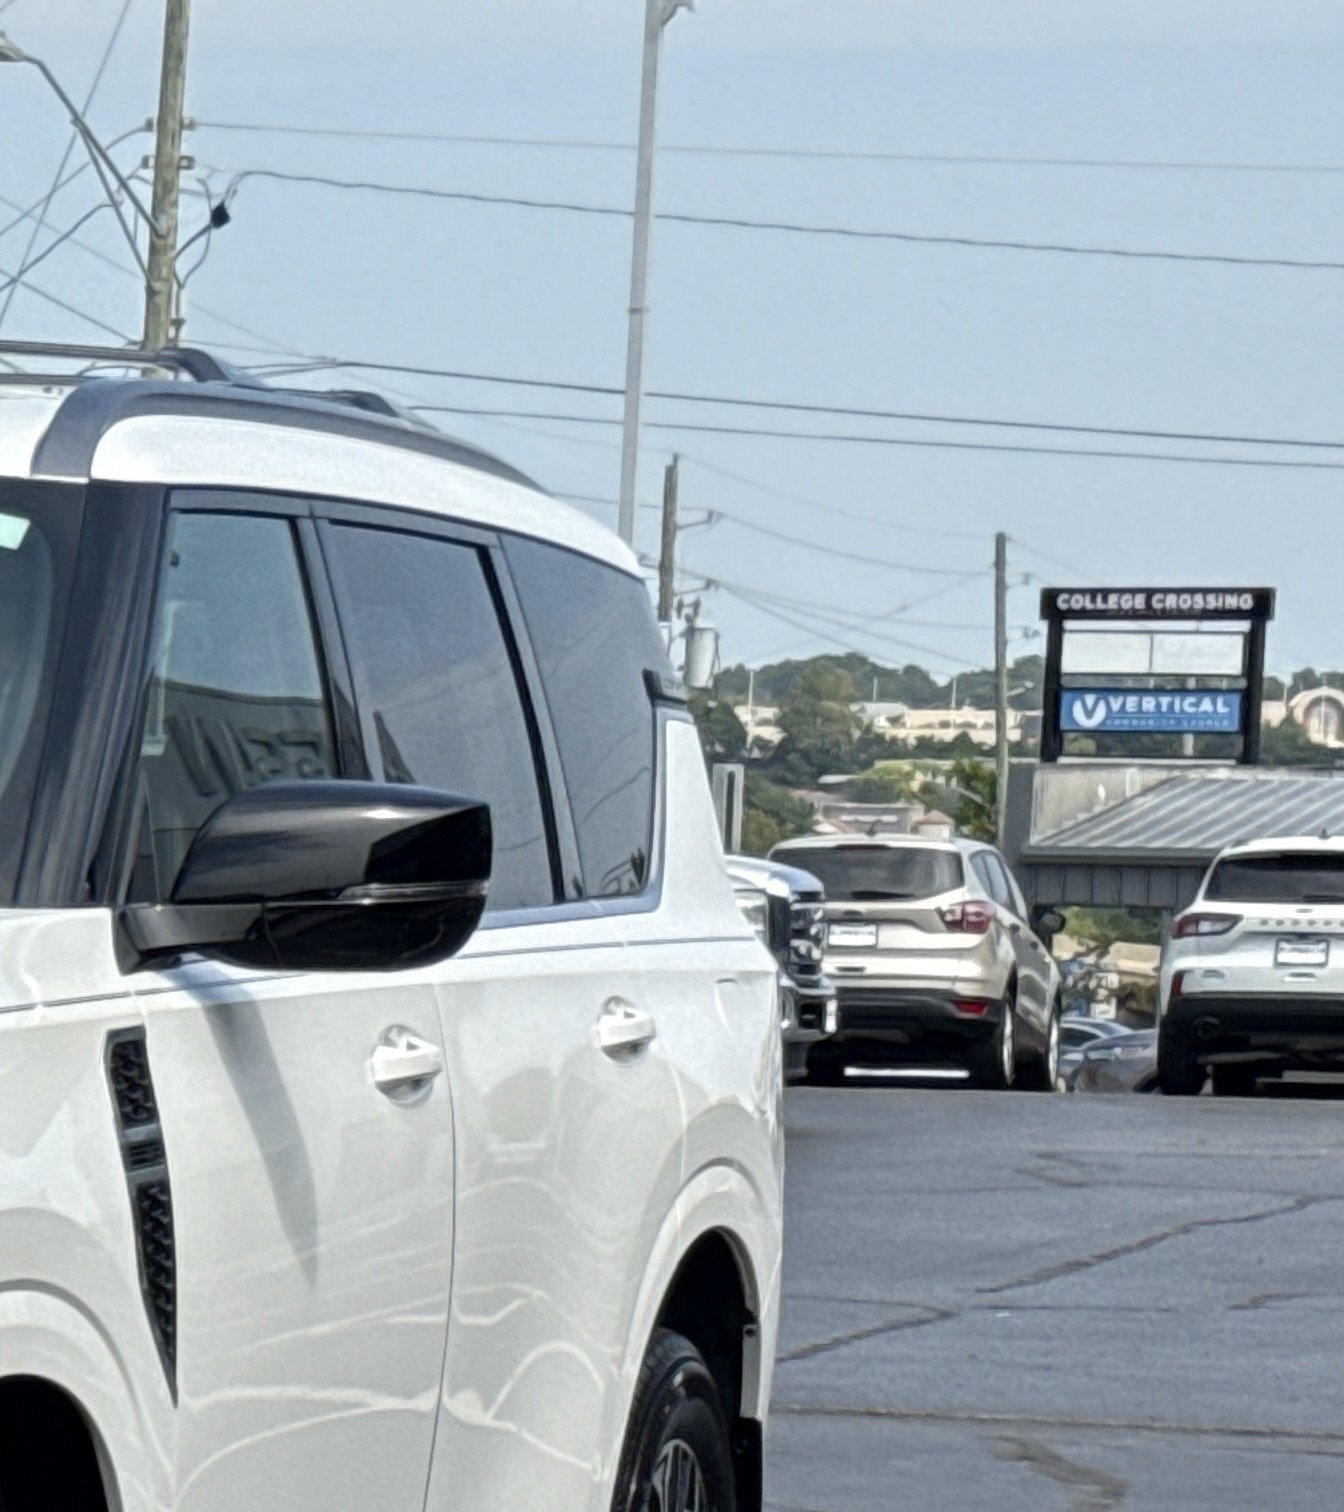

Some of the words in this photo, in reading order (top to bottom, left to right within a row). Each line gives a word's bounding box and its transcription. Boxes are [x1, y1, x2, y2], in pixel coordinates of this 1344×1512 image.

[1056, 592, 1147, 611] COLLEGE
[1151, 592, 1254, 611] CROSSING
[1107, 694, 1231, 714] VERTICAL
